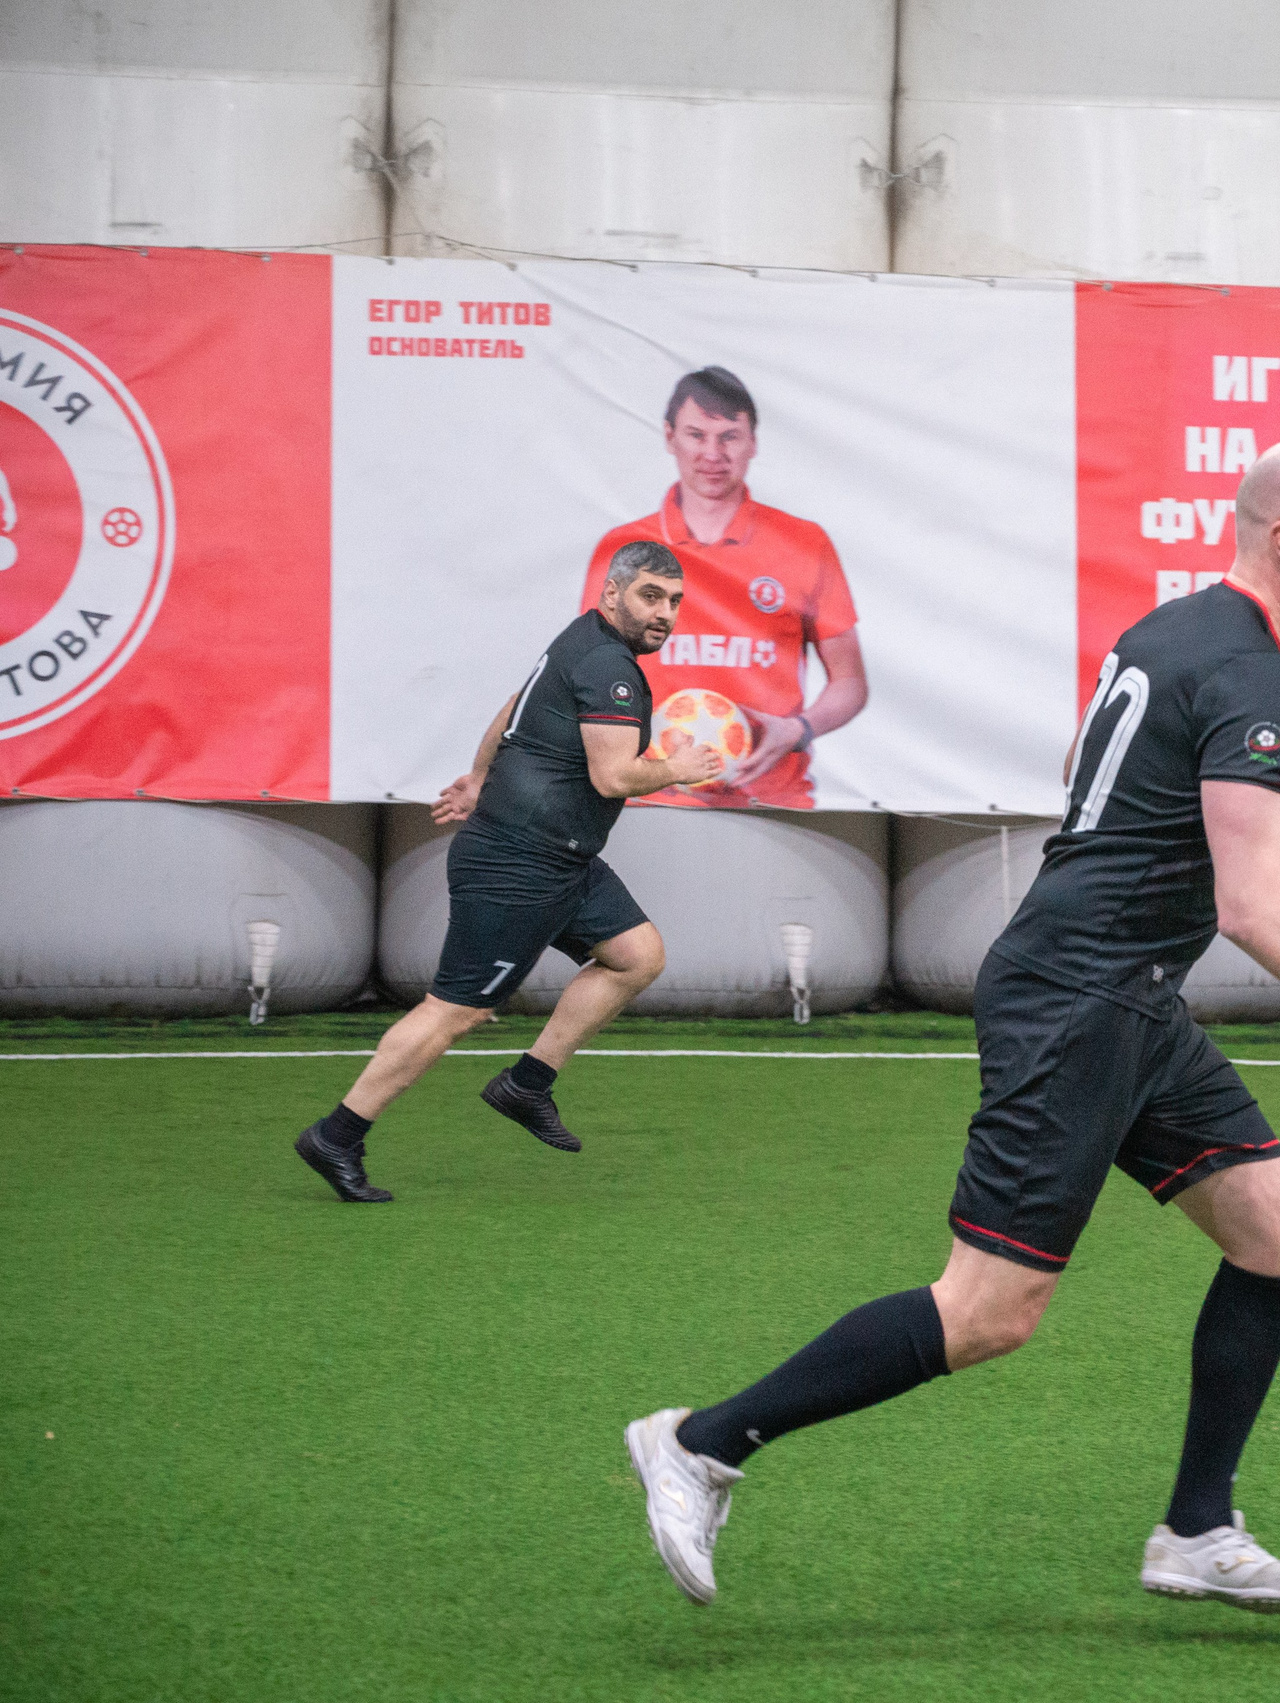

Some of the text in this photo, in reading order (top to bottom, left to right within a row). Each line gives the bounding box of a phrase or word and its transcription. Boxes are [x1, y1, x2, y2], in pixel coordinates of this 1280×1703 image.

[368, 298, 551, 326] ЕГОР ТИТОВ
[368, 336, 525, 359] ОСНОВАТЕЛЬ
[1185, 426, 1258, 473] НА
[0, 608, 113, 697] ТОВА
[480, 959, 516, 996] 7
